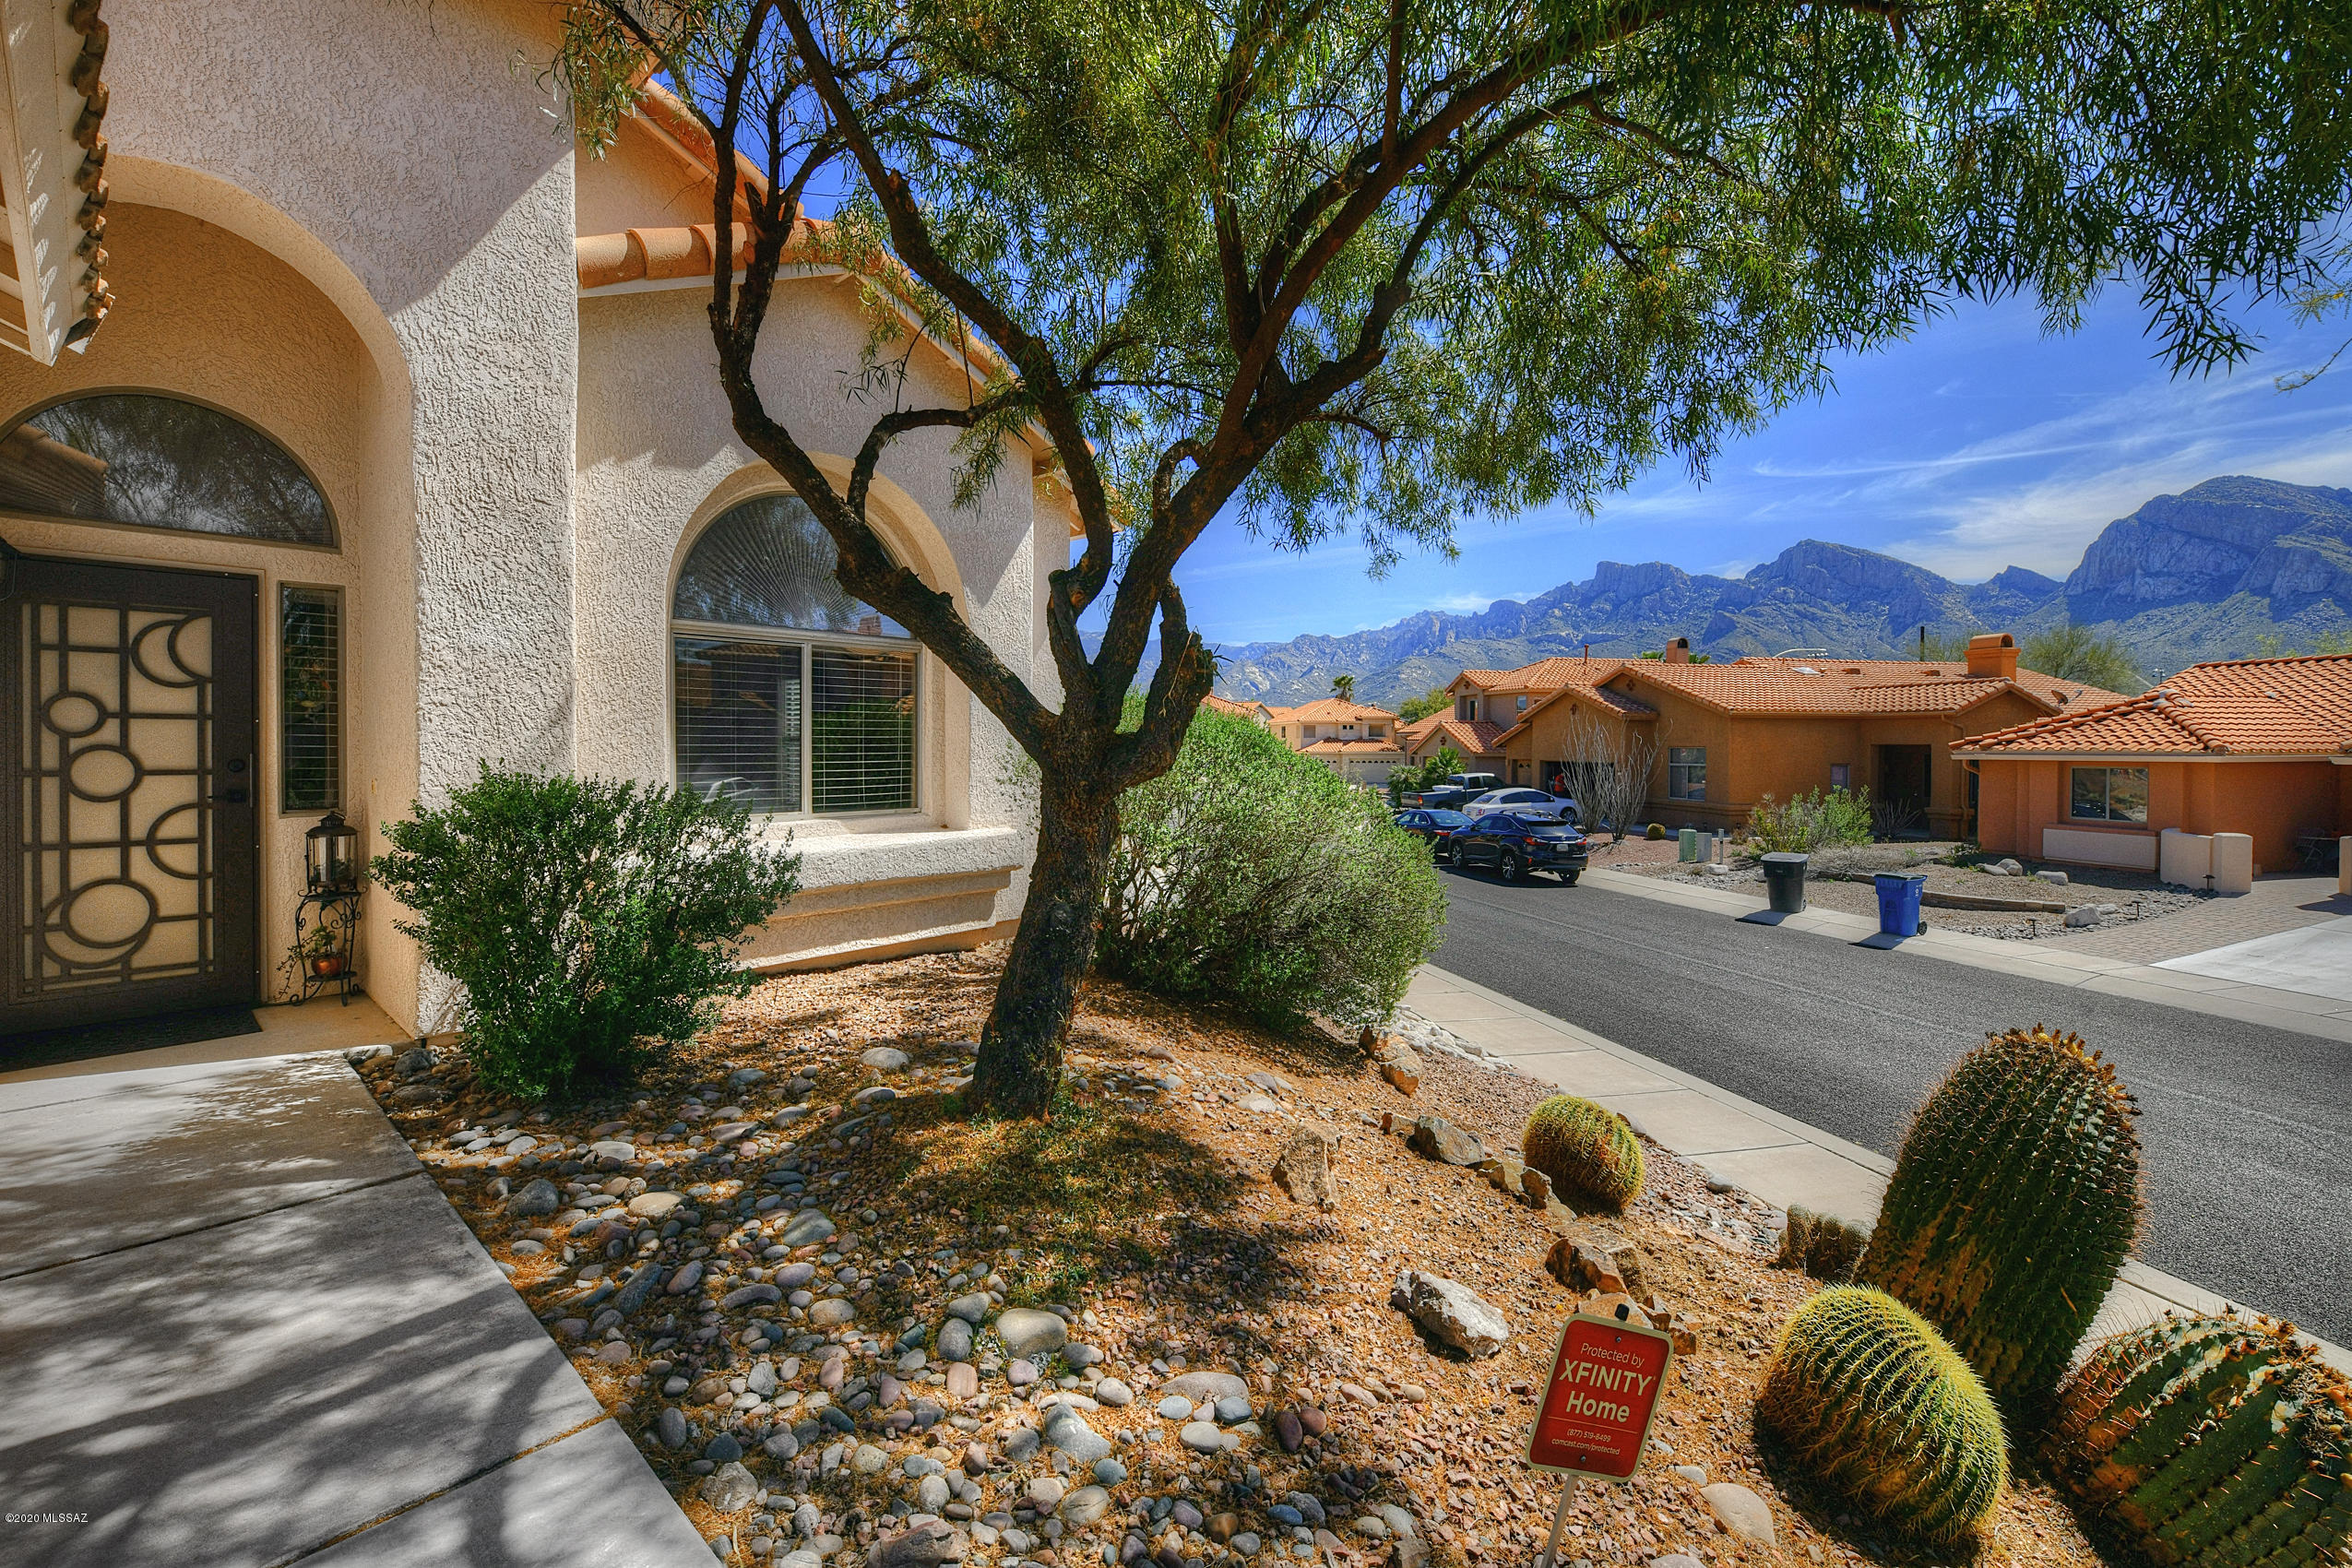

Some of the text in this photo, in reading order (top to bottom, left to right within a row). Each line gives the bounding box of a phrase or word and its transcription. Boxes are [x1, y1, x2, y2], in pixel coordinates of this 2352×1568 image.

[1581, 1343, 1645, 1368] Protected by
[1559, 1359, 1652, 1396] XFINITY
[1565, 1391, 1630, 1423] Home
[1567, 1429, 1583, 1438] (877)
[1551, 1438, 1621, 1455] comcast.com/protected
